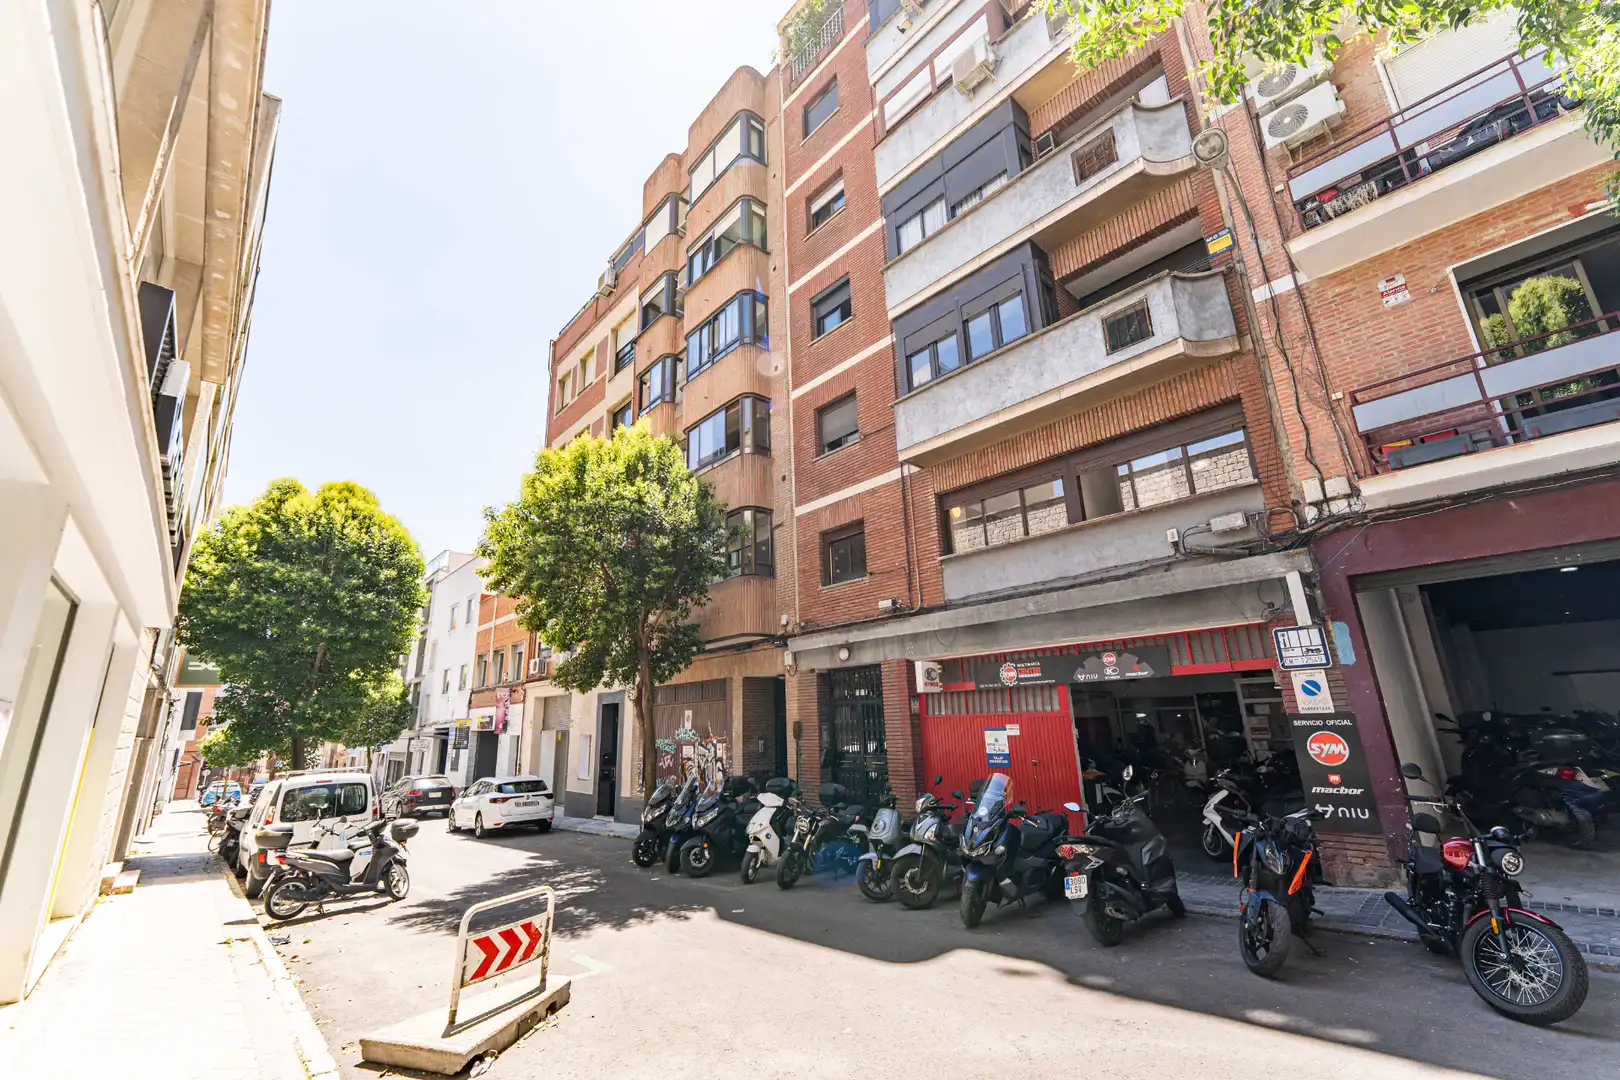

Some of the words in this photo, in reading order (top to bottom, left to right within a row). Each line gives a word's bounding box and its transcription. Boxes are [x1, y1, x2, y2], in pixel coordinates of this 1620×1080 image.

[1017, 666, 1041, 675] CENTER
[1309, 742, 1348, 758] SYM
[1311, 786, 1365, 795] macbor
[1070, 876, 1086, 886] 3090
